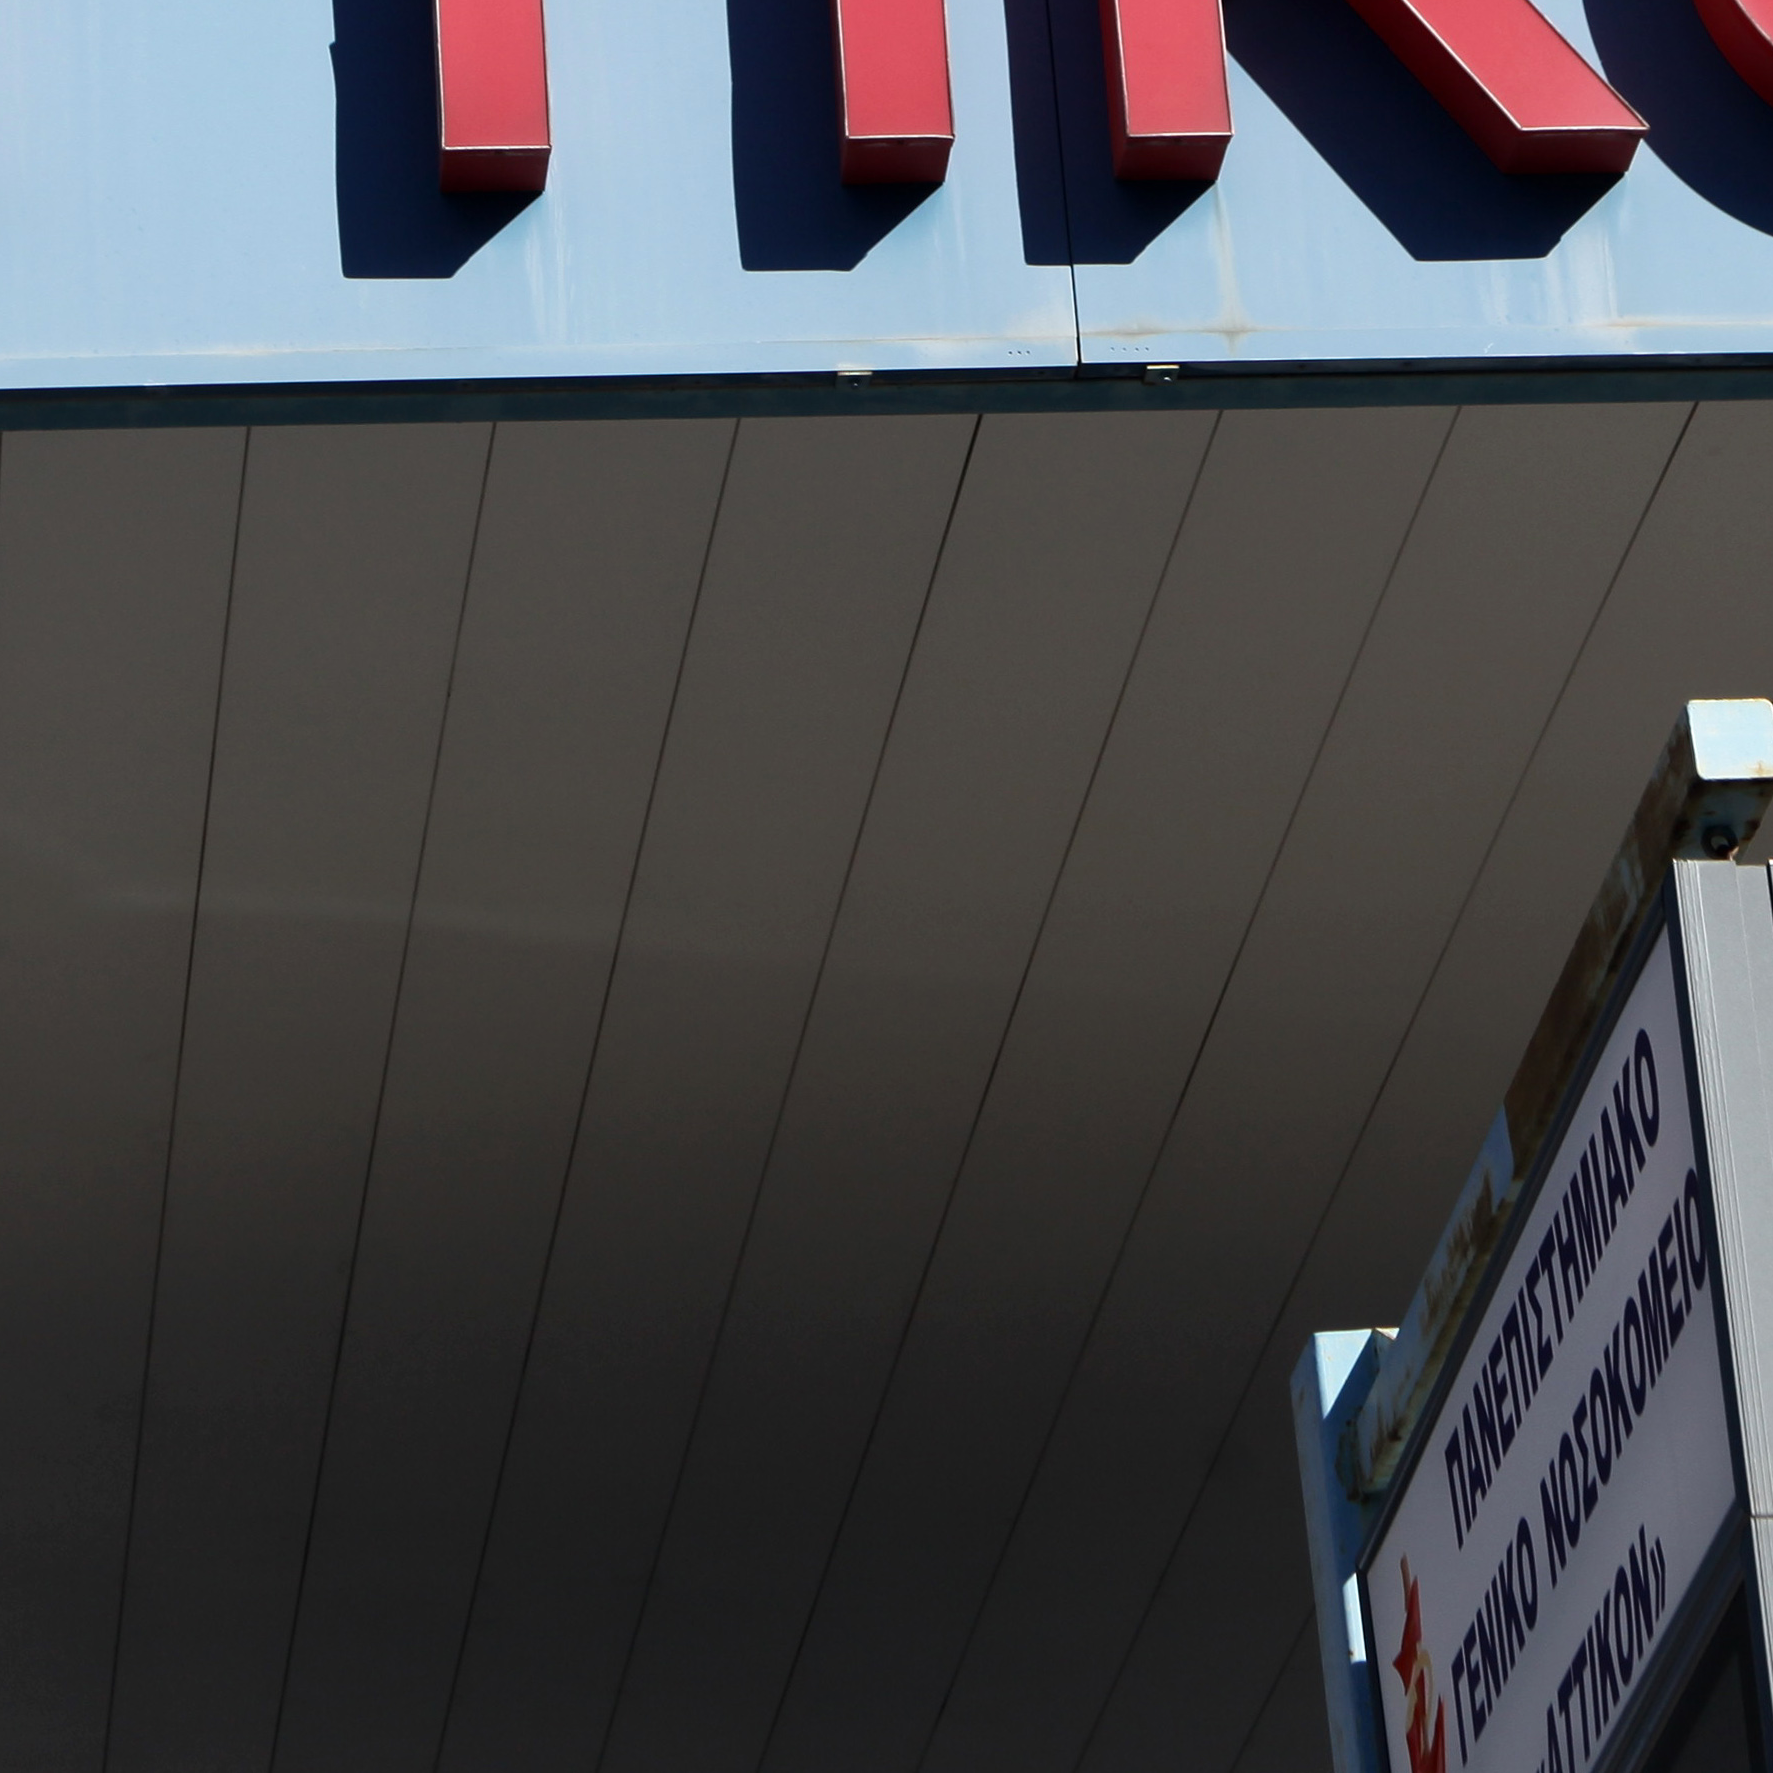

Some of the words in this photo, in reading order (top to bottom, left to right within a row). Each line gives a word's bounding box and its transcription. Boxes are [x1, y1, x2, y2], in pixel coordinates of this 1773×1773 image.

[1445, 1028, 1659, 1551] ΠΑΝΕΠΙΣΤΗΜΙΑΚΟ
[1452, 1517, 1538, 1767] ΓΕΝΙΚΟ
[1540, 1168, 1706, 1589] ΝΟΣΟΚΟΜΕΙΟ
[1535, 1523, 1666, 1773] ΑΤΤΙΚΟΝ»
